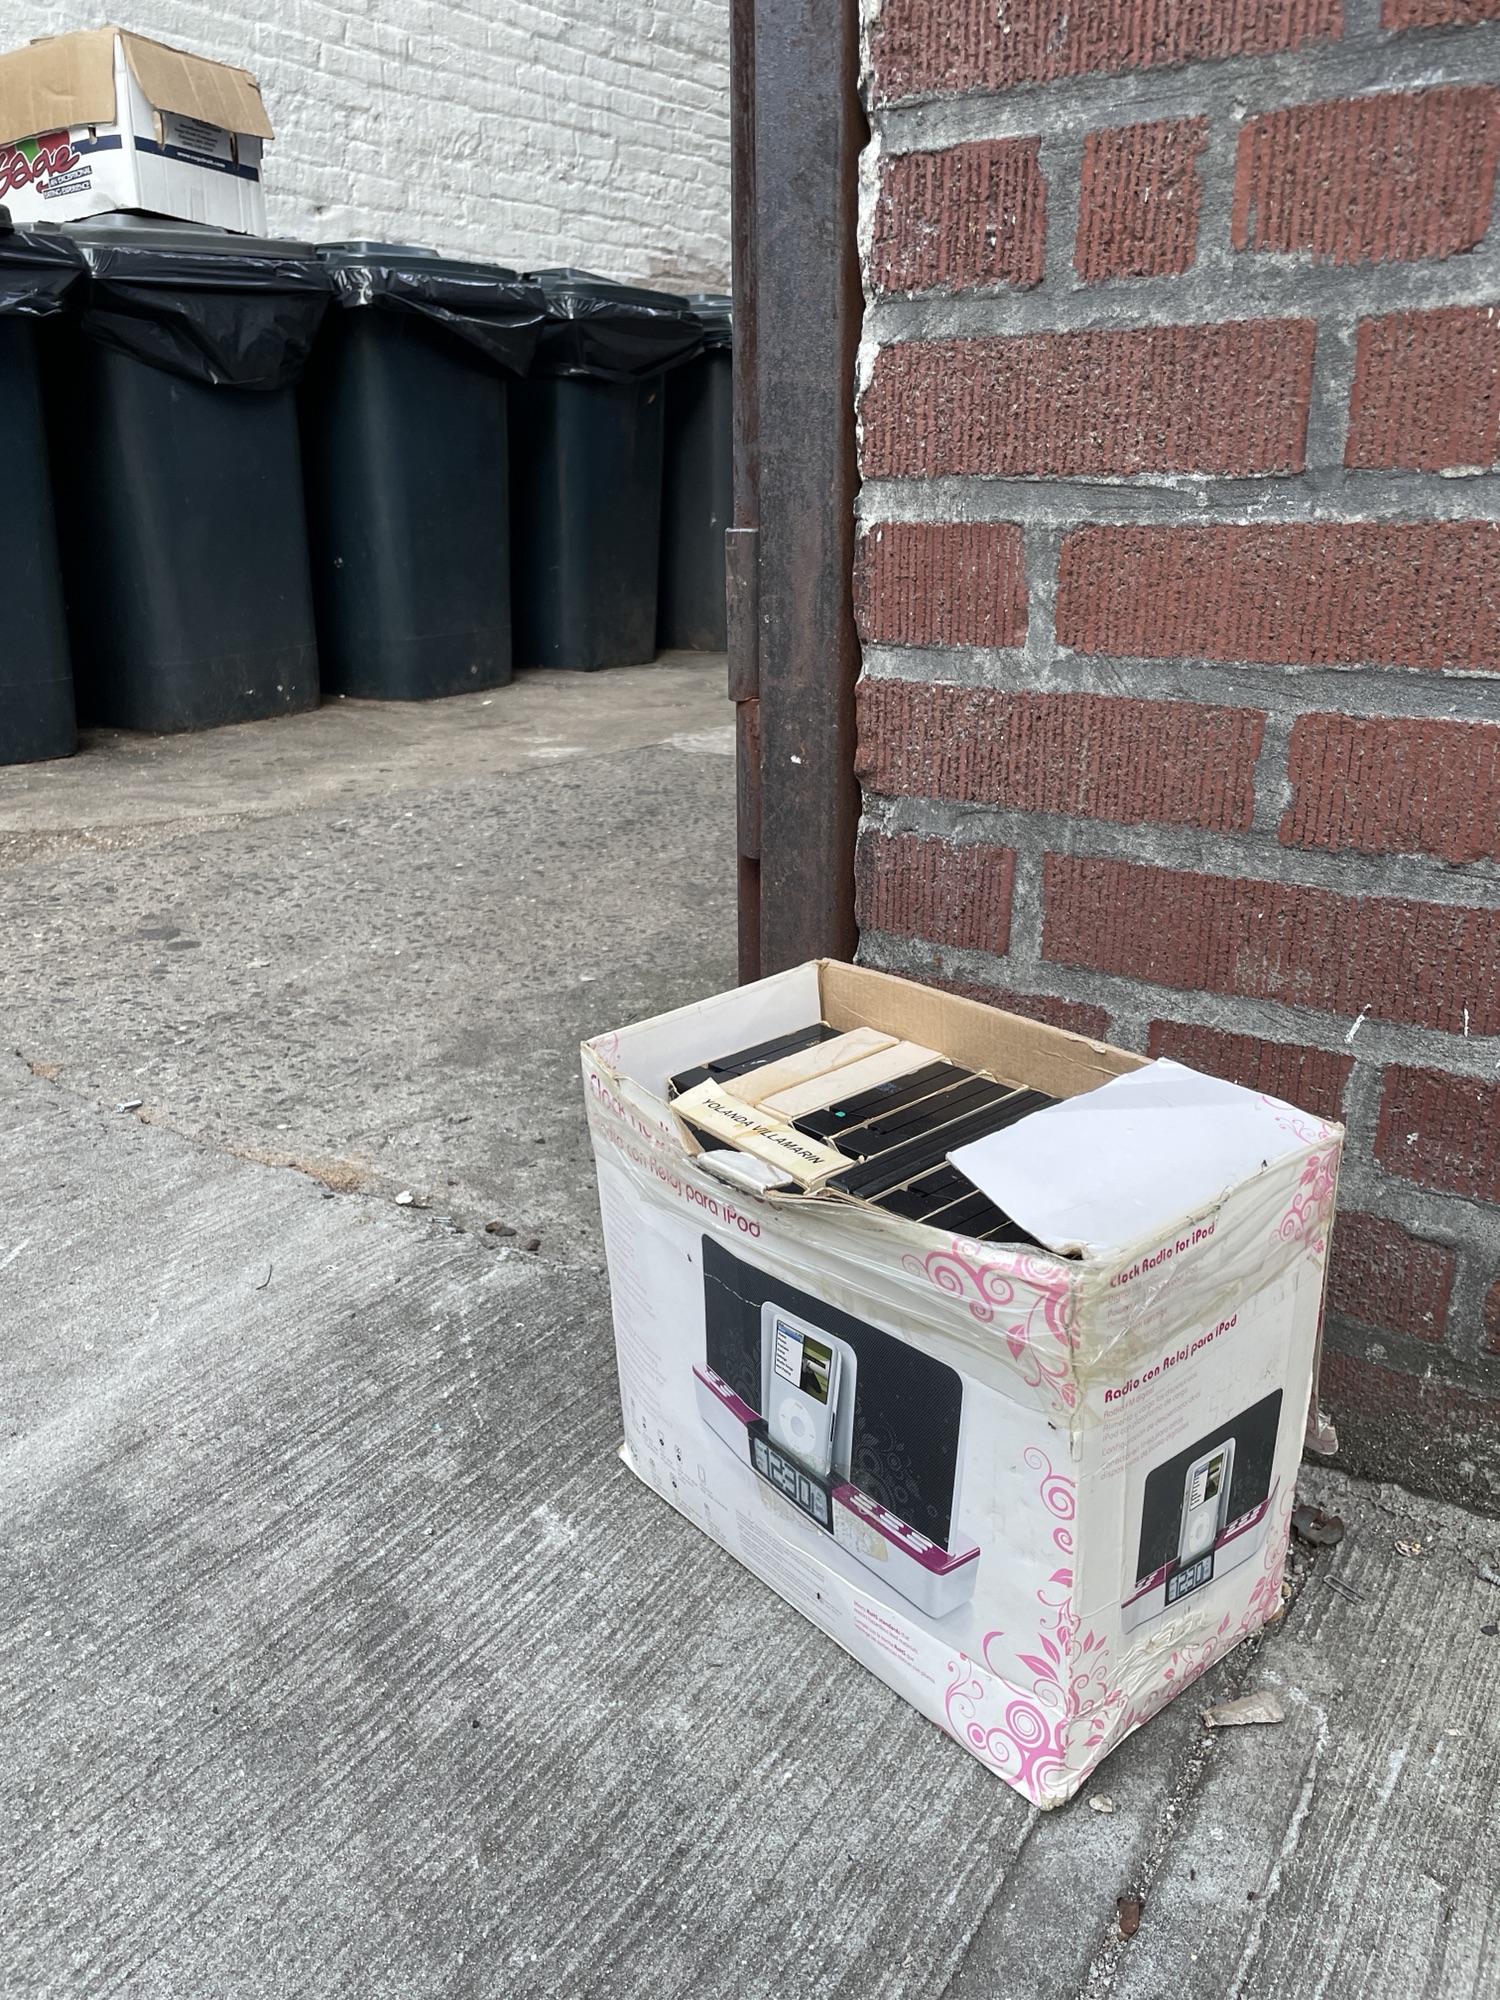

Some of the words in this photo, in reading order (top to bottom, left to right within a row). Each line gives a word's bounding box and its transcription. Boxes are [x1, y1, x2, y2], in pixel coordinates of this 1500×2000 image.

[702, 1098, 754, 1127] YOLANDA
[752, 1124, 825, 1164] VILLAMARIN
[686, 1184, 719, 1217] para
[722, 1202, 761, 1238] iPod
[1110, 1264, 1140, 1288] Clock
[1142, 1248, 1173, 1273] Radio
[1175, 1238, 1190, 1254] for
[1192, 1222, 1215, 1245] iPod
[1104, 1378, 1140, 1403] Radio
[1142, 1365, 1160, 1383] con
[1163, 1345, 1189, 1371] Reloj
[1190, 1332, 1214, 1357] para
[1215, 1314, 1238, 1338] iPod
